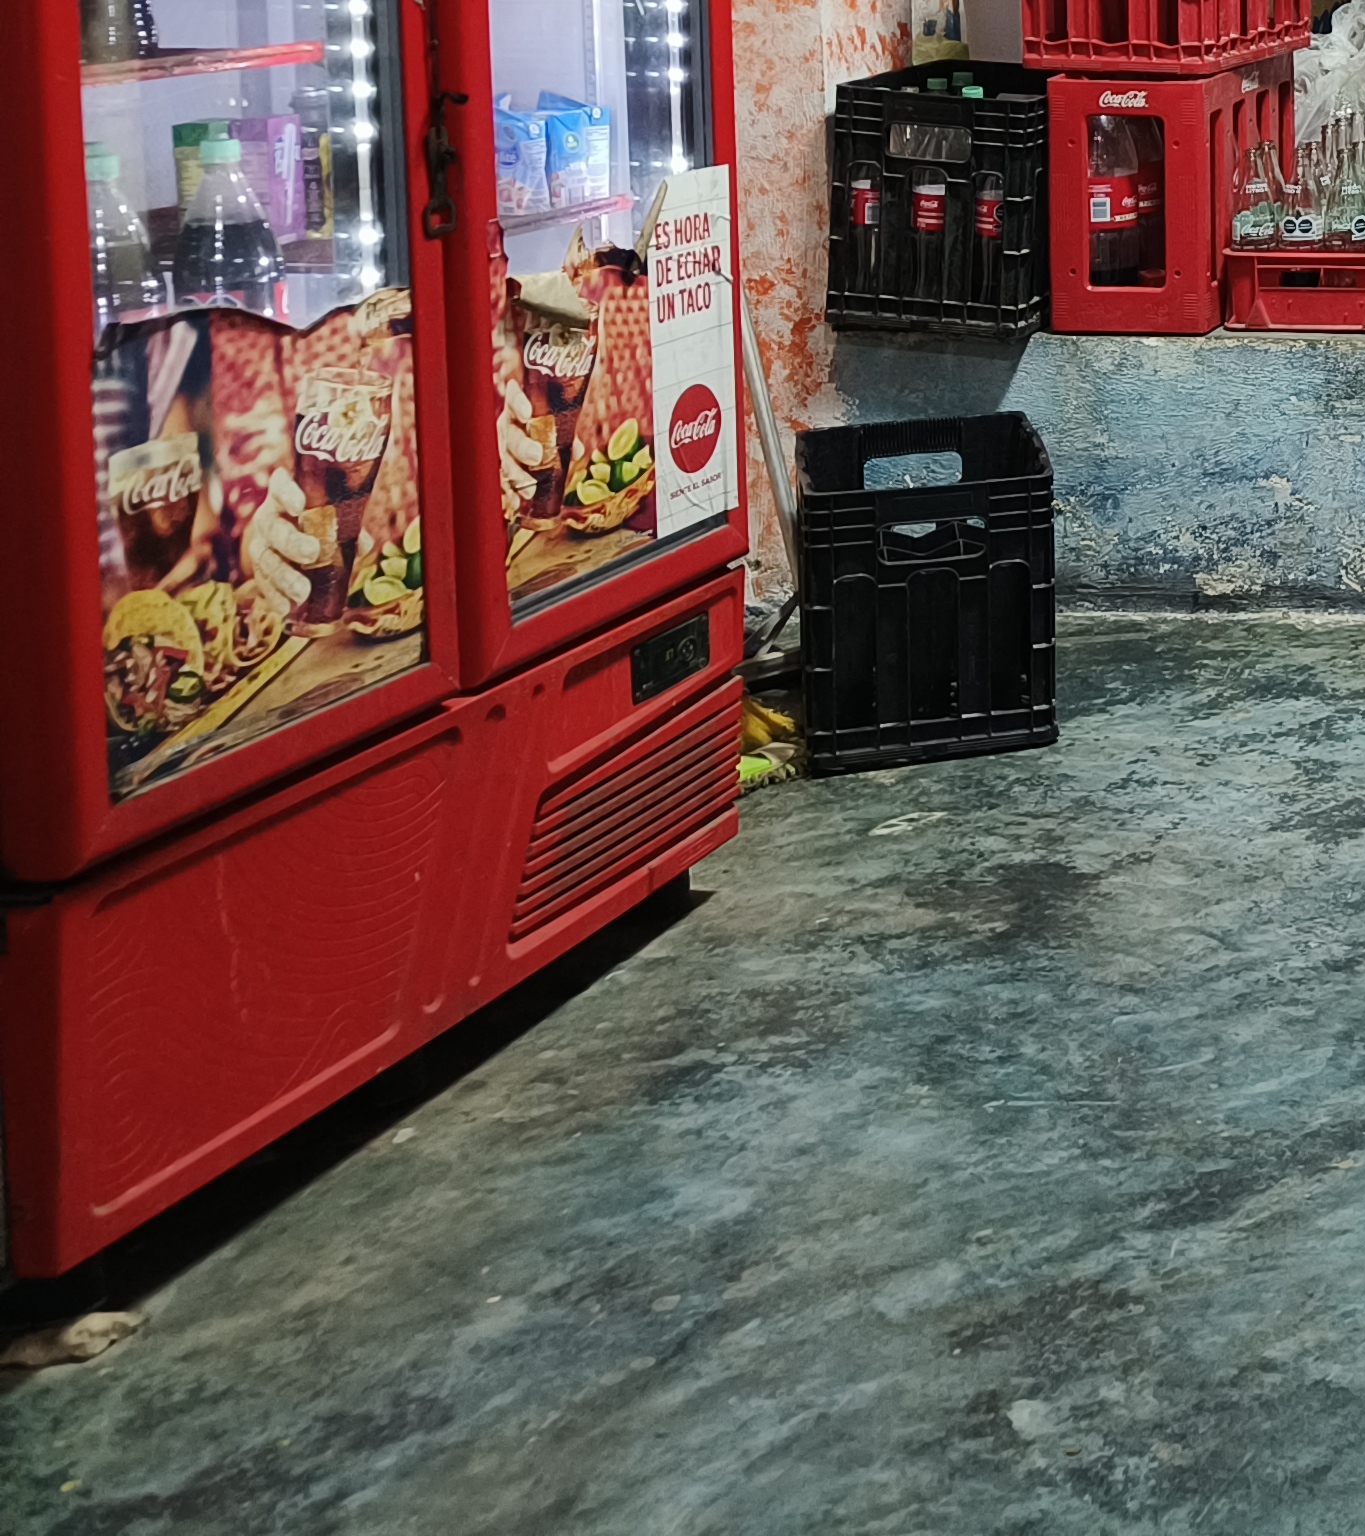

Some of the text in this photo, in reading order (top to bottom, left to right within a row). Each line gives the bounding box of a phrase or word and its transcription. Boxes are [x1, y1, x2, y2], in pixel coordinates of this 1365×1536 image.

[654, 212, 711, 251] ES HORA
[655, 245, 722, 288] DE ECHAR
[656, 281, 712, 324] UN TACO
